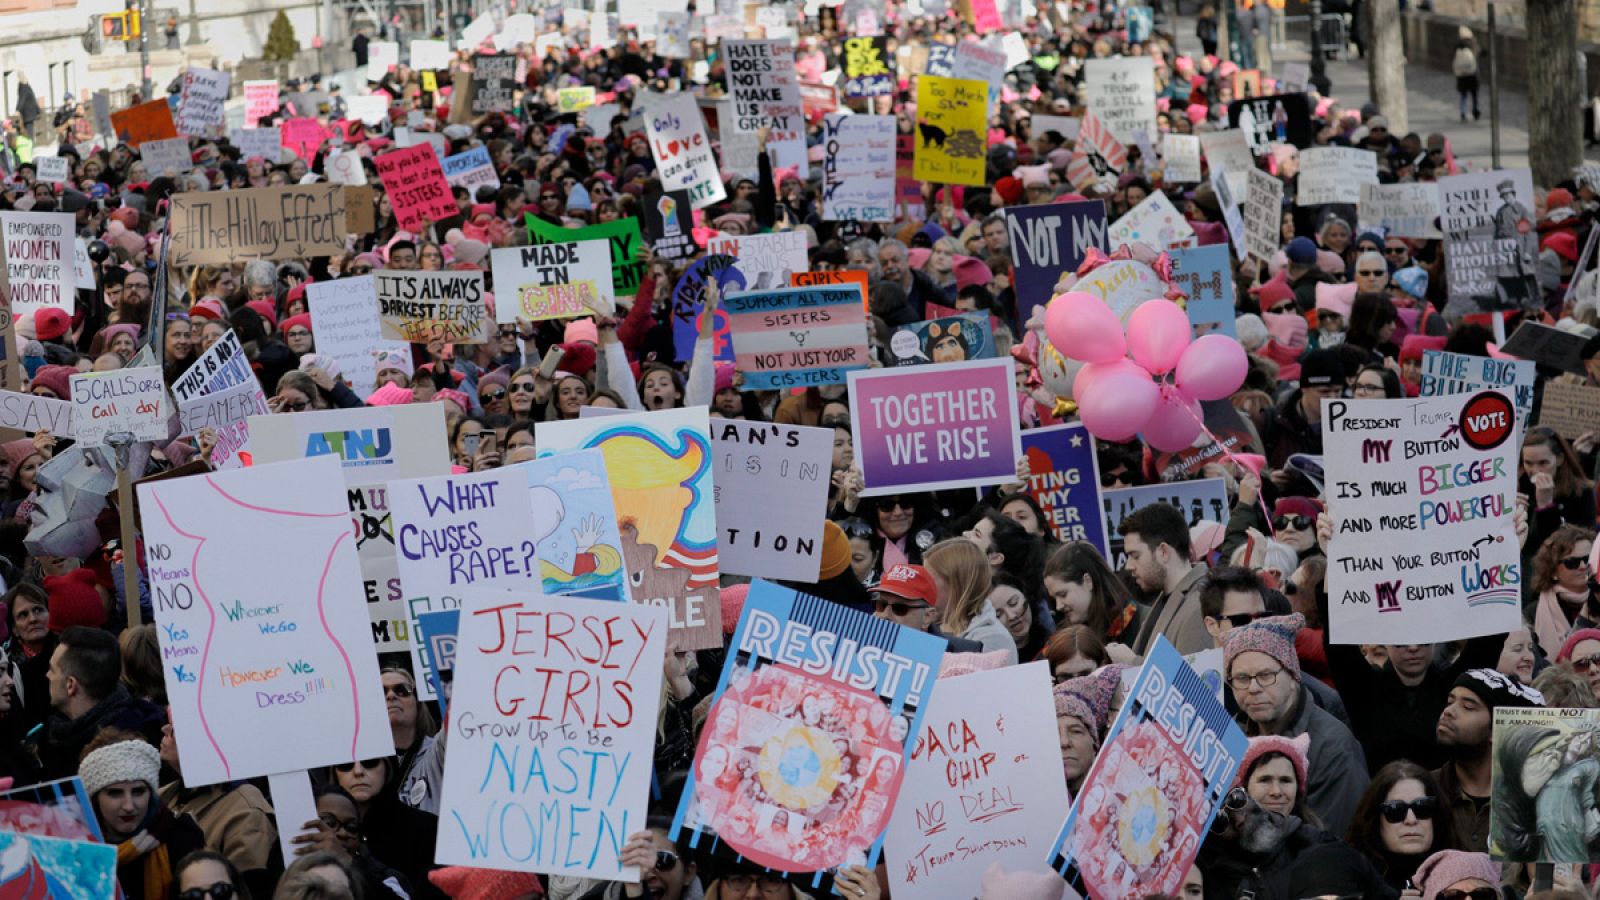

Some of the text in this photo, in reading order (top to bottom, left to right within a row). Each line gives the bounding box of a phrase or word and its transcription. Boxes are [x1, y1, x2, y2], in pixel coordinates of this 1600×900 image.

[727, 44, 768, 57] HATE
[731, 59, 772, 72] DOES
[733, 73, 762, 86] NOT
[1102, 83, 1140, 95] TRUMP
[735, 88, 782, 101] MAKE
[929, 82, 984, 102] Too Much
[1096, 95, 1144, 107] IS STILL
[737, 104, 759, 117] US
[1103, 108, 1136, 120] UNFIT
[654, 112, 680, 132] Only
[738, 116, 788, 130] GREAT
[664, 164, 682, 178] can
[682, 169, 698, 184] out
[395, 182, 444, 208] SISTERS
[689, 180, 715, 202] ATE
[1446, 188, 1488, 203] I STILL
[8, 222, 62, 237] EMPOWERED
[182, 193, 338, 257] #TheHillaryEffect
[8, 239, 61, 260] WOMEN
[1006, 213, 1108, 268] NOT MY
[1450, 239, 1517, 256] HAVE TO
[520, 242, 579, 267] MADE
[1451, 252, 1517, 268] PROTEST
[8, 263, 60, 280] EMPOWER
[537, 266, 569, 286] IN
[612, 262, 647, 289] ENT
[1454, 269, 1487, 281] THIS
[10, 283, 61, 304] WOMEN
[314, 285, 329, 300] I
[378, 276, 481, 302] IT'S ALWAYS
[735, 290, 852, 310] SUPPORT ALL YOUR
[379, 298, 485, 320] DARKEST BEFORE
[764, 310, 831, 327] SISTERS
[400, 320, 481, 342] THE DAWN
[176, 332, 237, 400] THIS IS NOT
[755, 347, 856, 369] NOT JUST YOUR
[1424, 351, 1516, 385] THE BIG
[771, 369, 840, 386] CIS-TERS
[74, 376, 161, 404] 5CALLS.ORG
[92, 402, 118, 419] Call
[136, 400, 160, 418] day
[180, 391, 254, 433] REAMERS
[870, 388, 998, 430] TOGETHER
[1466, 411, 1507, 433] VOTE
[304, 427, 393, 461] ATNJ
[885, 426, 990, 466] WE RISE
[1361, 438, 1460, 464] MY BUTTON
[725, 453, 819, 481] IS IN
[1336, 457, 1506, 499] IS MUCH BIGGER
[1029, 468, 1081, 491] TING
[417, 480, 499, 517] WHAT
[1039, 488, 1071, 508] MY
[1043, 507, 1081, 525] PER
[1340, 495, 1513, 533] AND MORE POWERFUL
[400, 521, 483, 560] CAUSES
[727, 528, 814, 556] TION
[1053, 525, 1088, 543] ER
[150, 543, 171, 561] NO
[450, 540, 536, 585] RAPE?
[1337, 548, 1480, 573] THAN YOUR BUTTON
[151, 567, 190, 581] Means
[1341, 564, 1520, 606] AND MY BUTTON WORKS
[156, 583, 193, 612] NO
[220, 600, 284, 623] Wherever
[163, 625, 189, 642] Yes
[473, 603, 655, 680] JERSEY
[164, 645, 199, 660] Means
[739, 608, 931, 706] RESIST!
[173, 664, 196, 684] Yes
[220, 660, 315, 688] However We
[494, 665, 633, 729] GIRLS
[1560, 708, 1585, 718] NOT
[457, 712, 614, 748] Grow Up To Be
[1137, 664, 1236, 794] RESIST!
[480, 742, 632, 806] NASTY
[946, 752, 996, 788] CHIP
[916, 786, 1024, 829] NO DEAL
[451, 799, 628, 873] WOMEN
